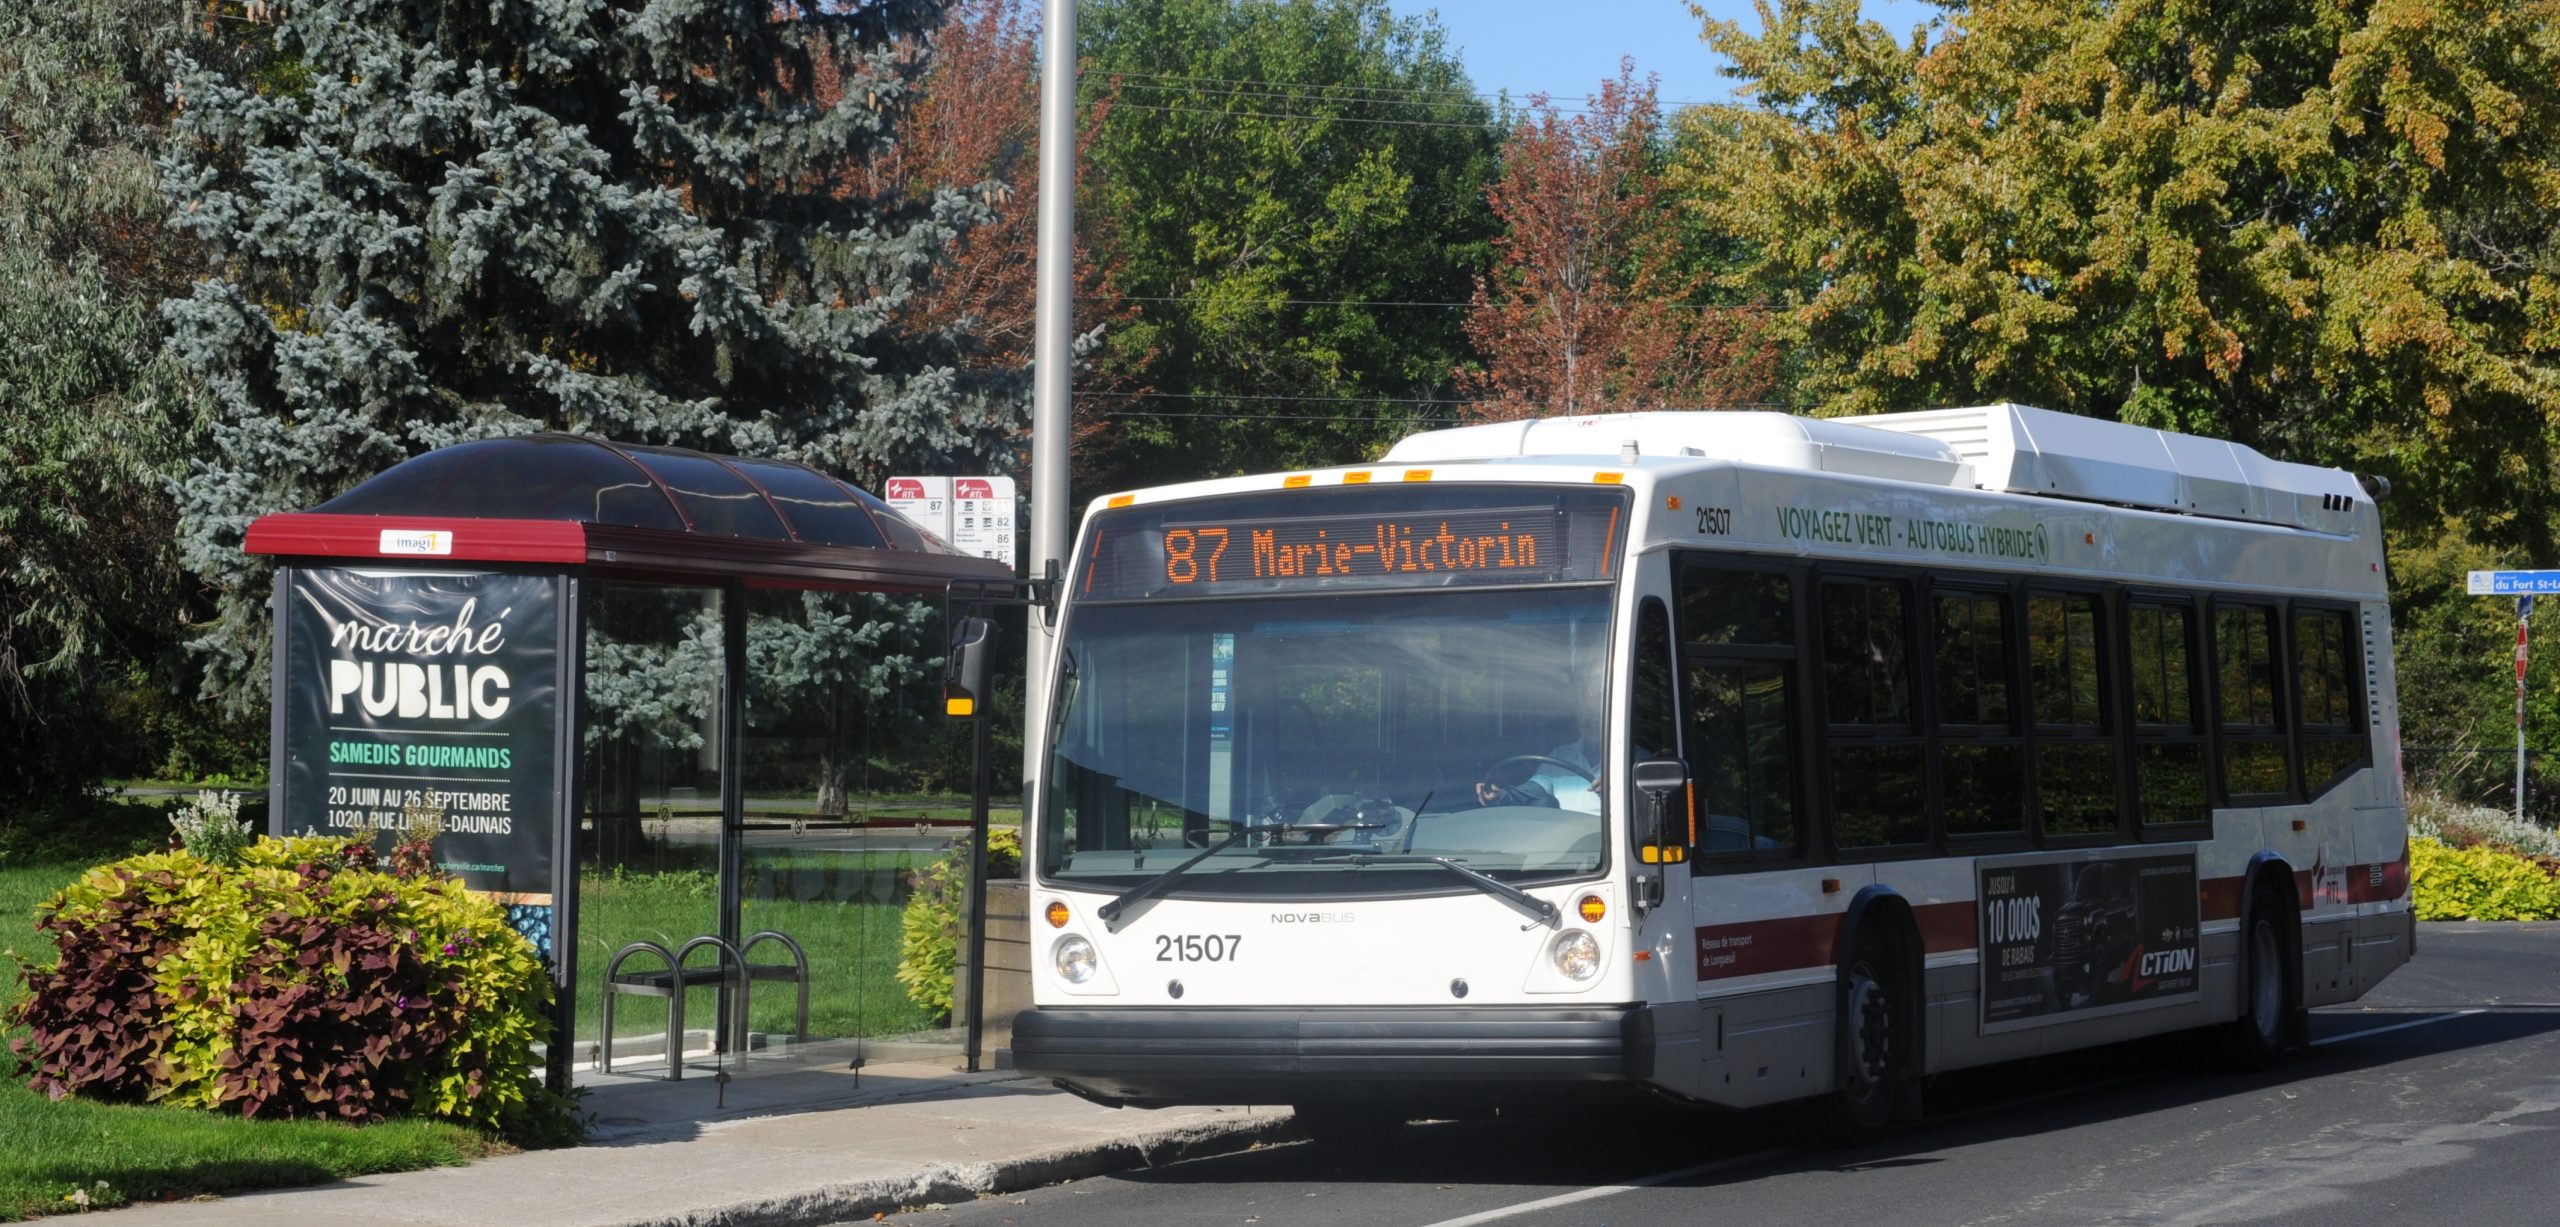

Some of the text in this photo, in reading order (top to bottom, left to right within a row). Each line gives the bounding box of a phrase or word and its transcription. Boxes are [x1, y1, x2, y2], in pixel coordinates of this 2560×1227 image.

[930, 501, 942, 511] 87
[997, 517, 1009, 527] 82
[1697, 506, 1731, 535] 21507
[1777, 506, 1853, 543] VOYAGEZ
[1855, 514, 1894, 547] VERT
[1907, 519, 1974, 553] AUTOBUS
[1978, 526, 2035, 558] HYBRIDE
[997, 534, 1009, 544] 86
[1165, 521, 1536, 584] 87 Marie-Victorin
[2495, 580, 2510, 590] du
[2513, 580, 2534, 590] Fort
[330, 597, 512, 655] marché
[330, 658, 511, 720] PUBLIC
[329, 741, 511, 769] SAMEDIS GOURMANDS
[328, 786, 511, 812] 20 JUIN AU 26 SEPTEMBRE
[369, 811, 396, 830] RUE
[2326, 881, 2341, 905] RTL
[1988, 892, 2041, 945] 10 000$
[1155, 934, 1242, 962] 21507
[1721, 935, 1728, 948] de
[1729, 934, 1752, 949] transport
[1703, 956, 1711, 967] de
[2001, 948, 2012, 967] DE
